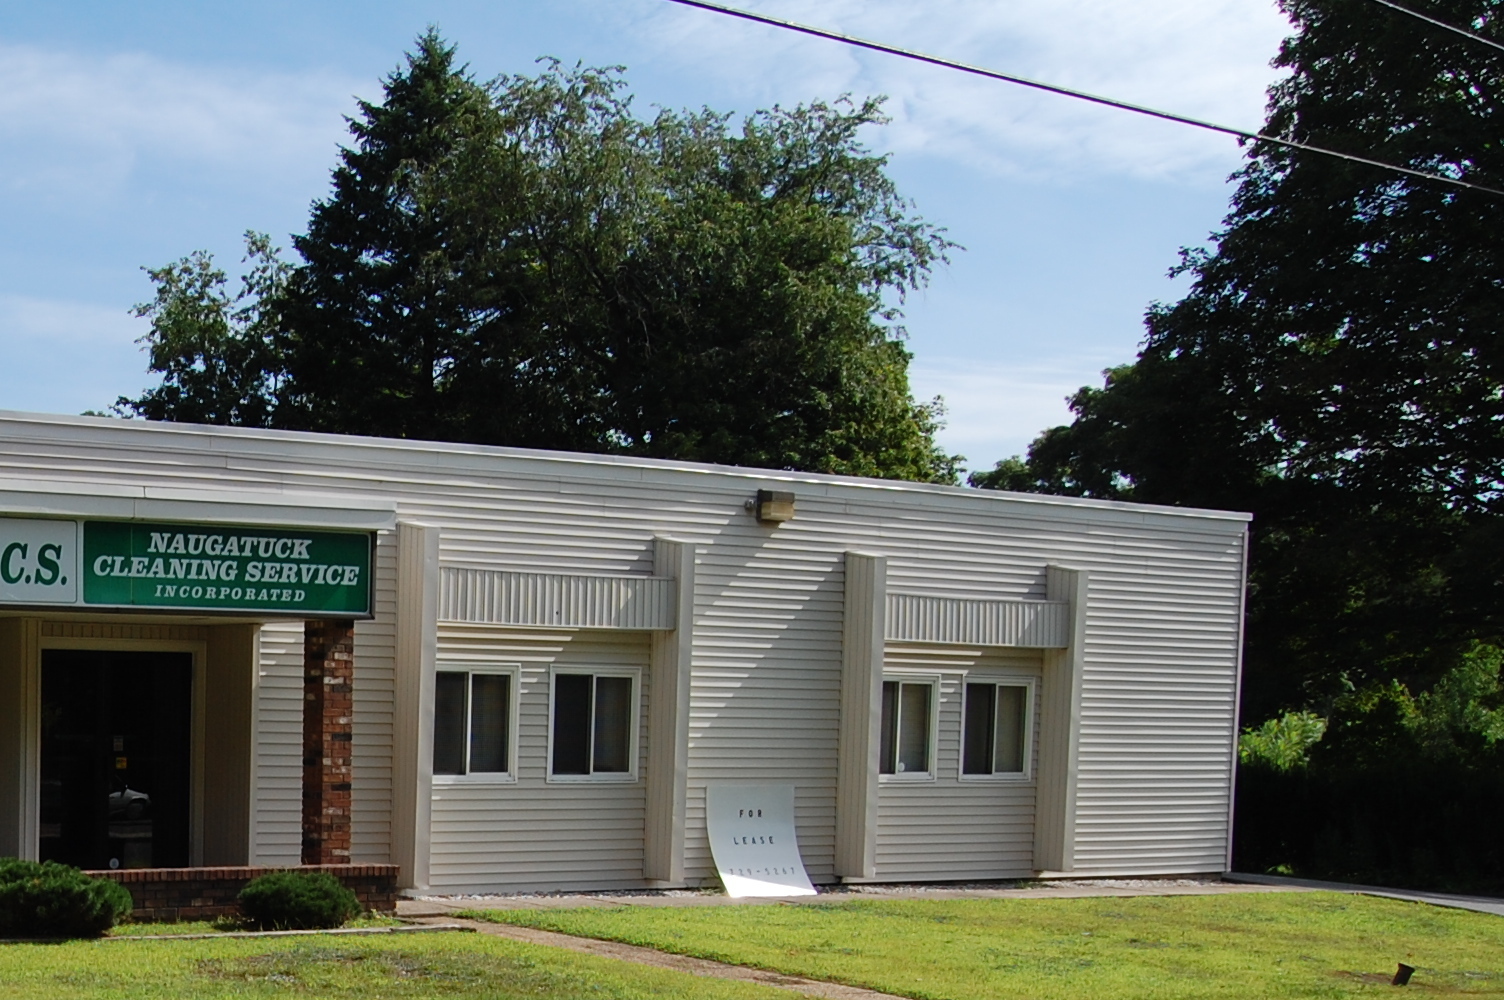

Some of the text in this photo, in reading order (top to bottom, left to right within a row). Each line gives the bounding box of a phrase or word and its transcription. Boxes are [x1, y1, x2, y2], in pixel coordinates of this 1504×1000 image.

[147, 532, 312, 559] NAUGATUCK
[93, 556, 359, 586] CLEANING SERVICE
[154, 584, 306, 602] INCORPORATED
[739, 809, 762, 818] FOR
[733, 836, 775, 845] LEASE
